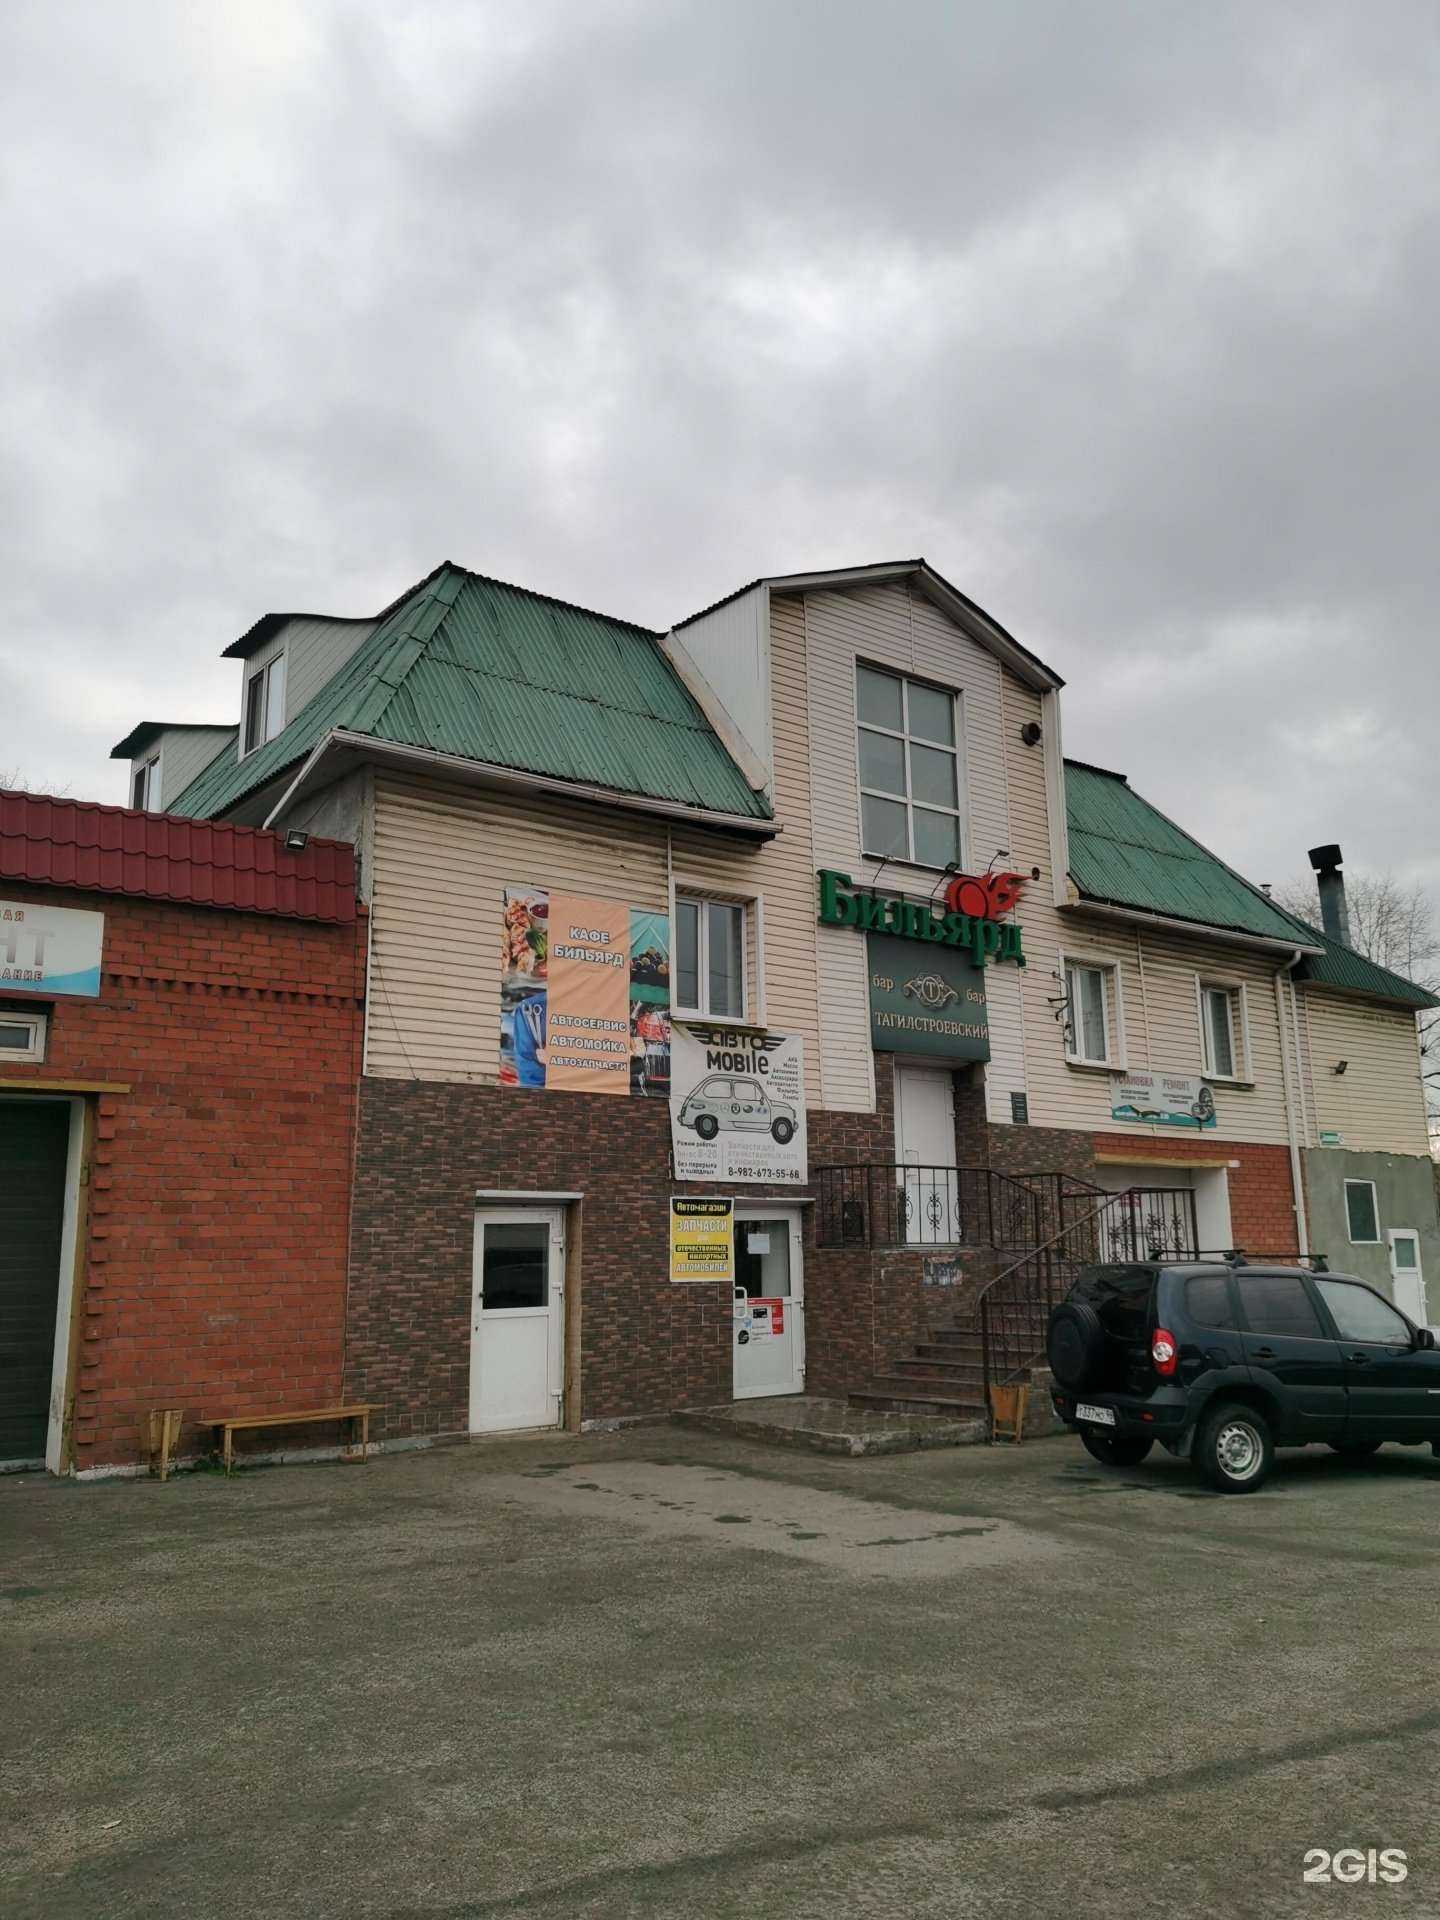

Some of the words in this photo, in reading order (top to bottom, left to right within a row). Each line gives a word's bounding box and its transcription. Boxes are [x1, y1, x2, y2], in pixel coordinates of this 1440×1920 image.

[0, 909, 24, 922] АЯ
[816, 869, 1026, 968] Бильярд
[569, 926, 609, 944] КАФЕ
[554, 944, 624, 968] БИЛЬЯРД
[0, 968, 42, 982] АНИЕ
[873, 974, 894, 992] бар
[966, 989, 986, 1005] бар
[550, 1014, 627, 1032] АВТОСЕРВИС
[874, 1011, 989, 1039] ТАГИЛСТРОЕВСКИЙ
[550, 1035, 627, 1053] АВТОМОЙКА
[550, 1056, 627, 1071] АВТОЗАПЧАСТИ
[677, 1202, 726, 1212] Автомагазин
[677, 1219, 727, 1232] ЗАПЧАСТИ
